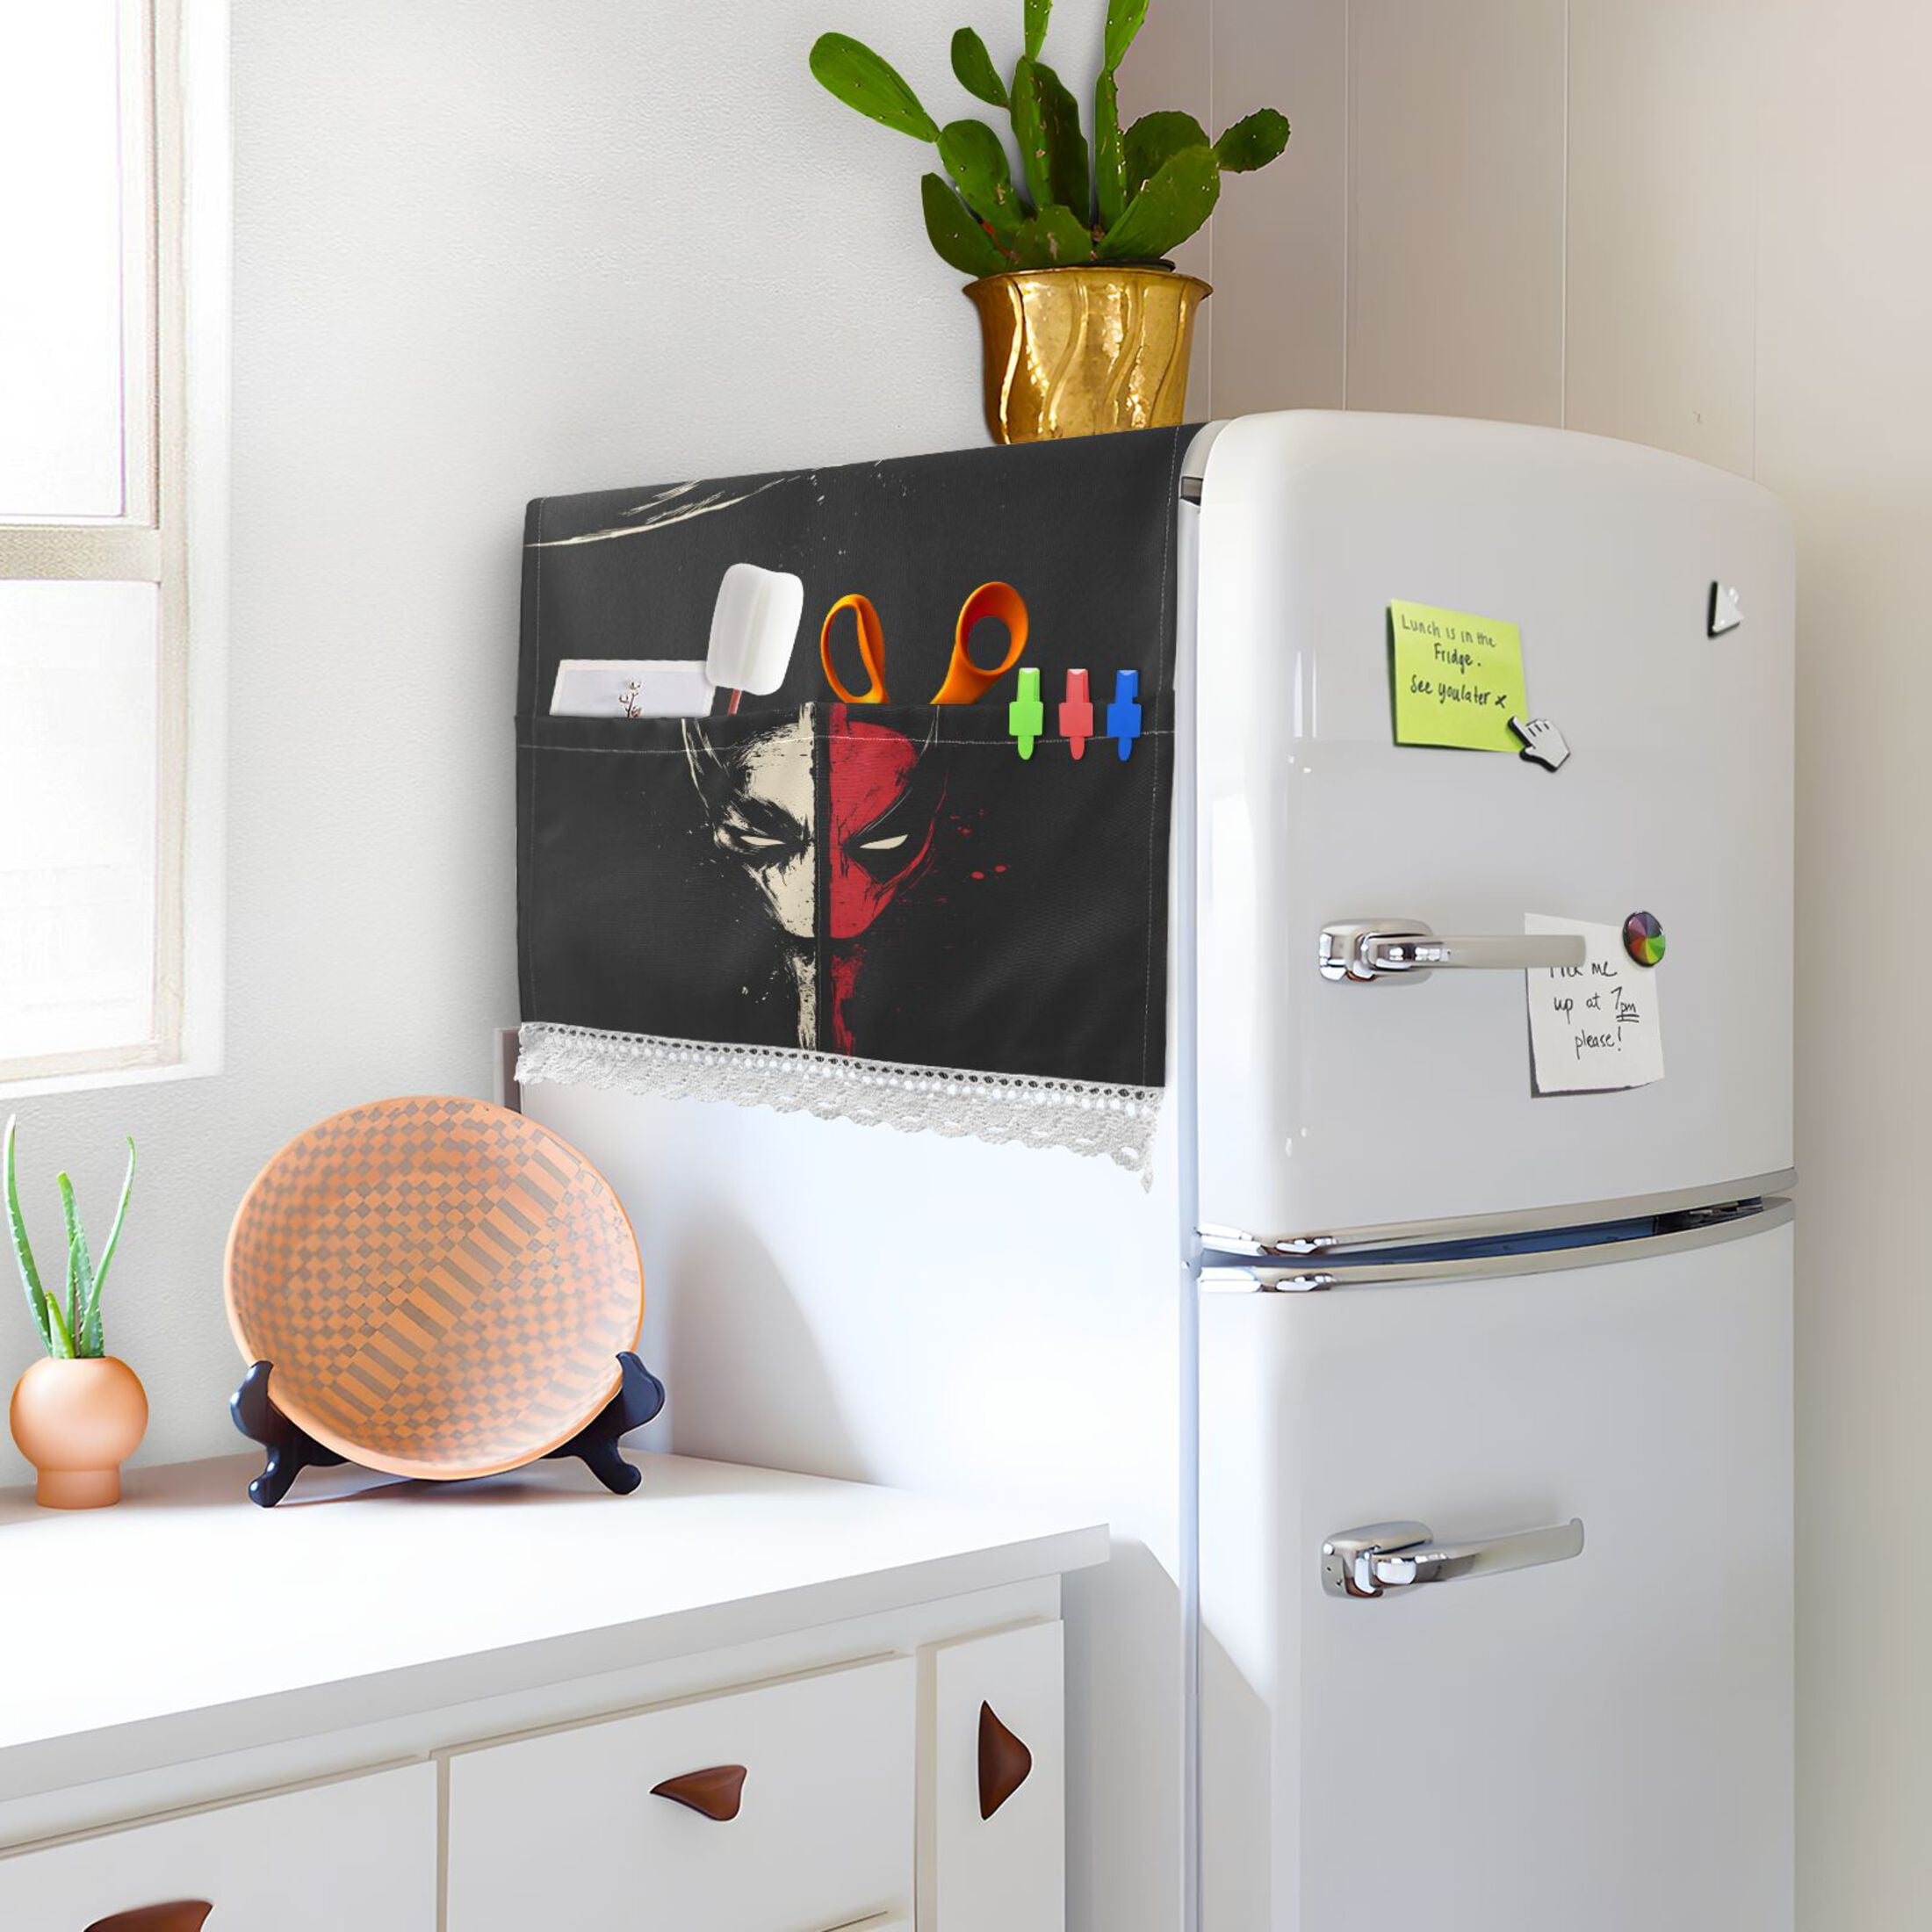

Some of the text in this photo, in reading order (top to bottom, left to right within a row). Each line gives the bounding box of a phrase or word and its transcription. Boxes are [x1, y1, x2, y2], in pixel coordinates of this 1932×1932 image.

[1401, 614, 1440, 639] Lunch
[1460, 630, 1474, 644] in
[1476, 631, 1496, 648] the
[1410, 674, 1433, 694] See
[1554, 997, 1575, 1025] up
[1586, 992, 1601, 1011] at
[1575, 1026, 1622, 1060] please!
